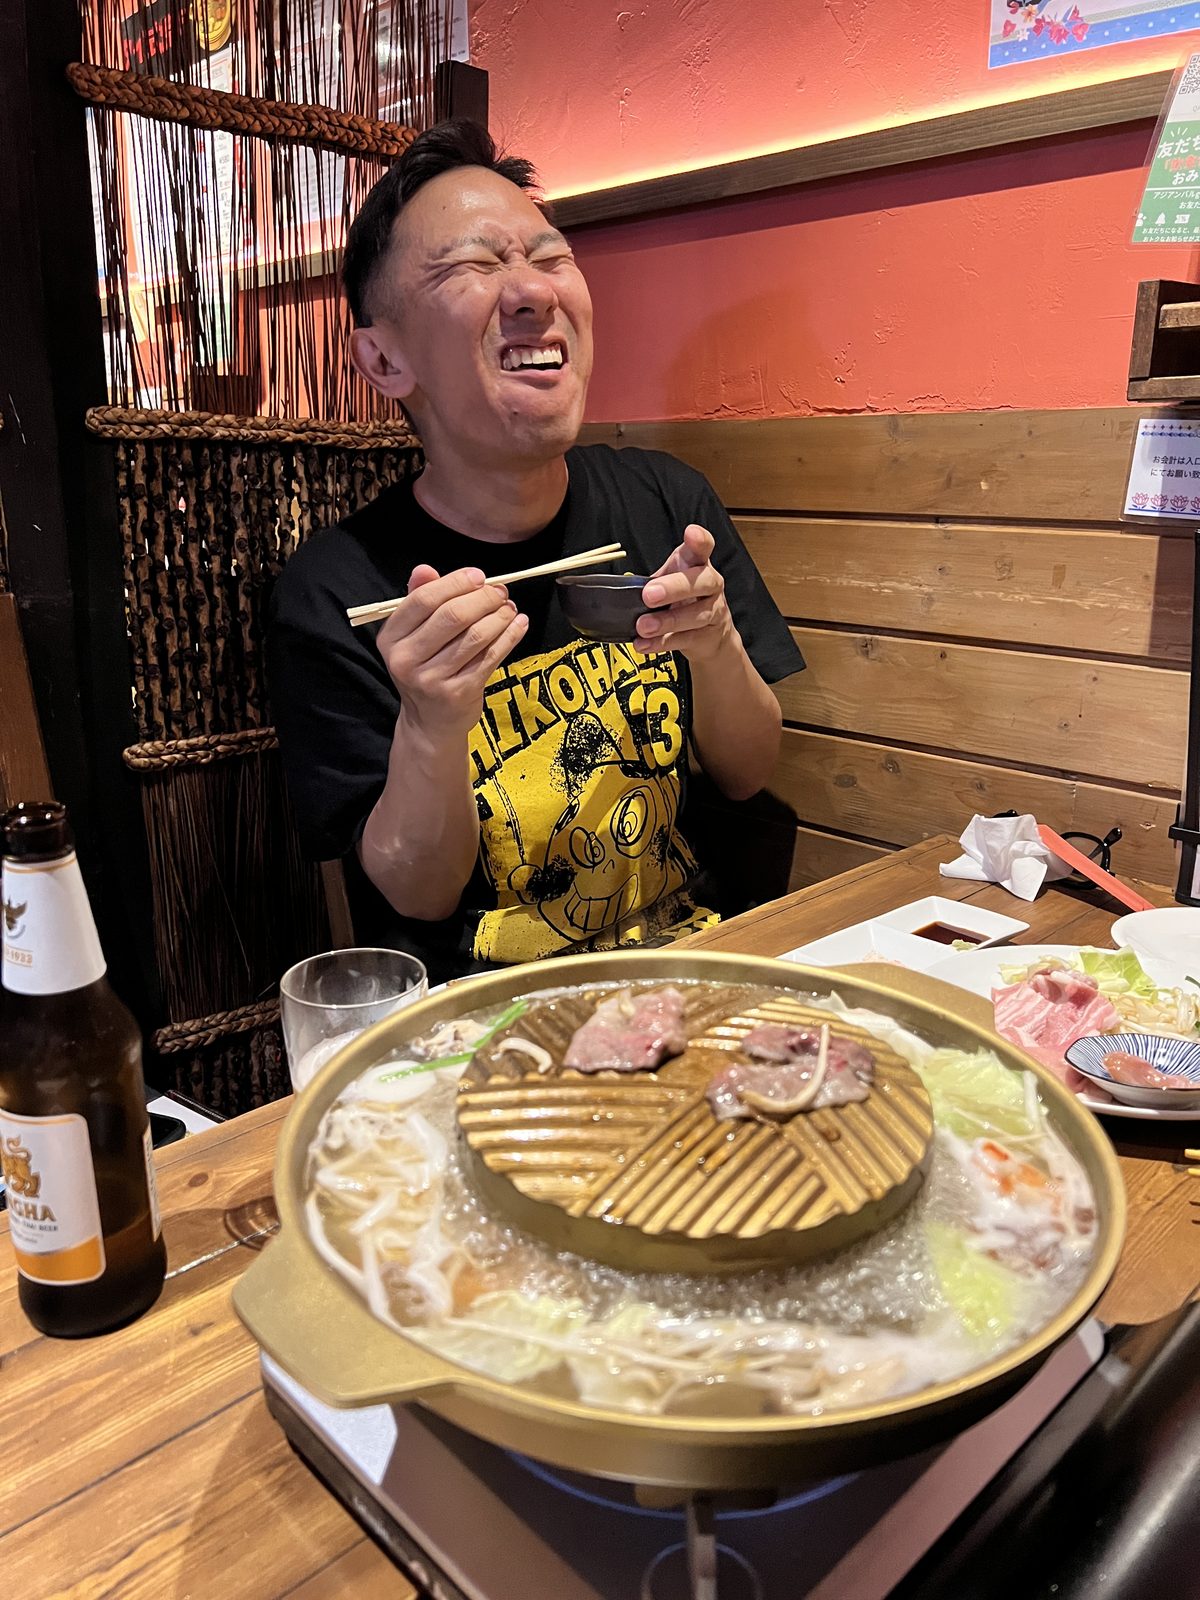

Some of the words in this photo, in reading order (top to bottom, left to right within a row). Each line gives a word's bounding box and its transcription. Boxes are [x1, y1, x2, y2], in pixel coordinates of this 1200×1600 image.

[1172, 169, 1200, 185] おみ
[1153, 455, 1200, 466] お会計は入口
